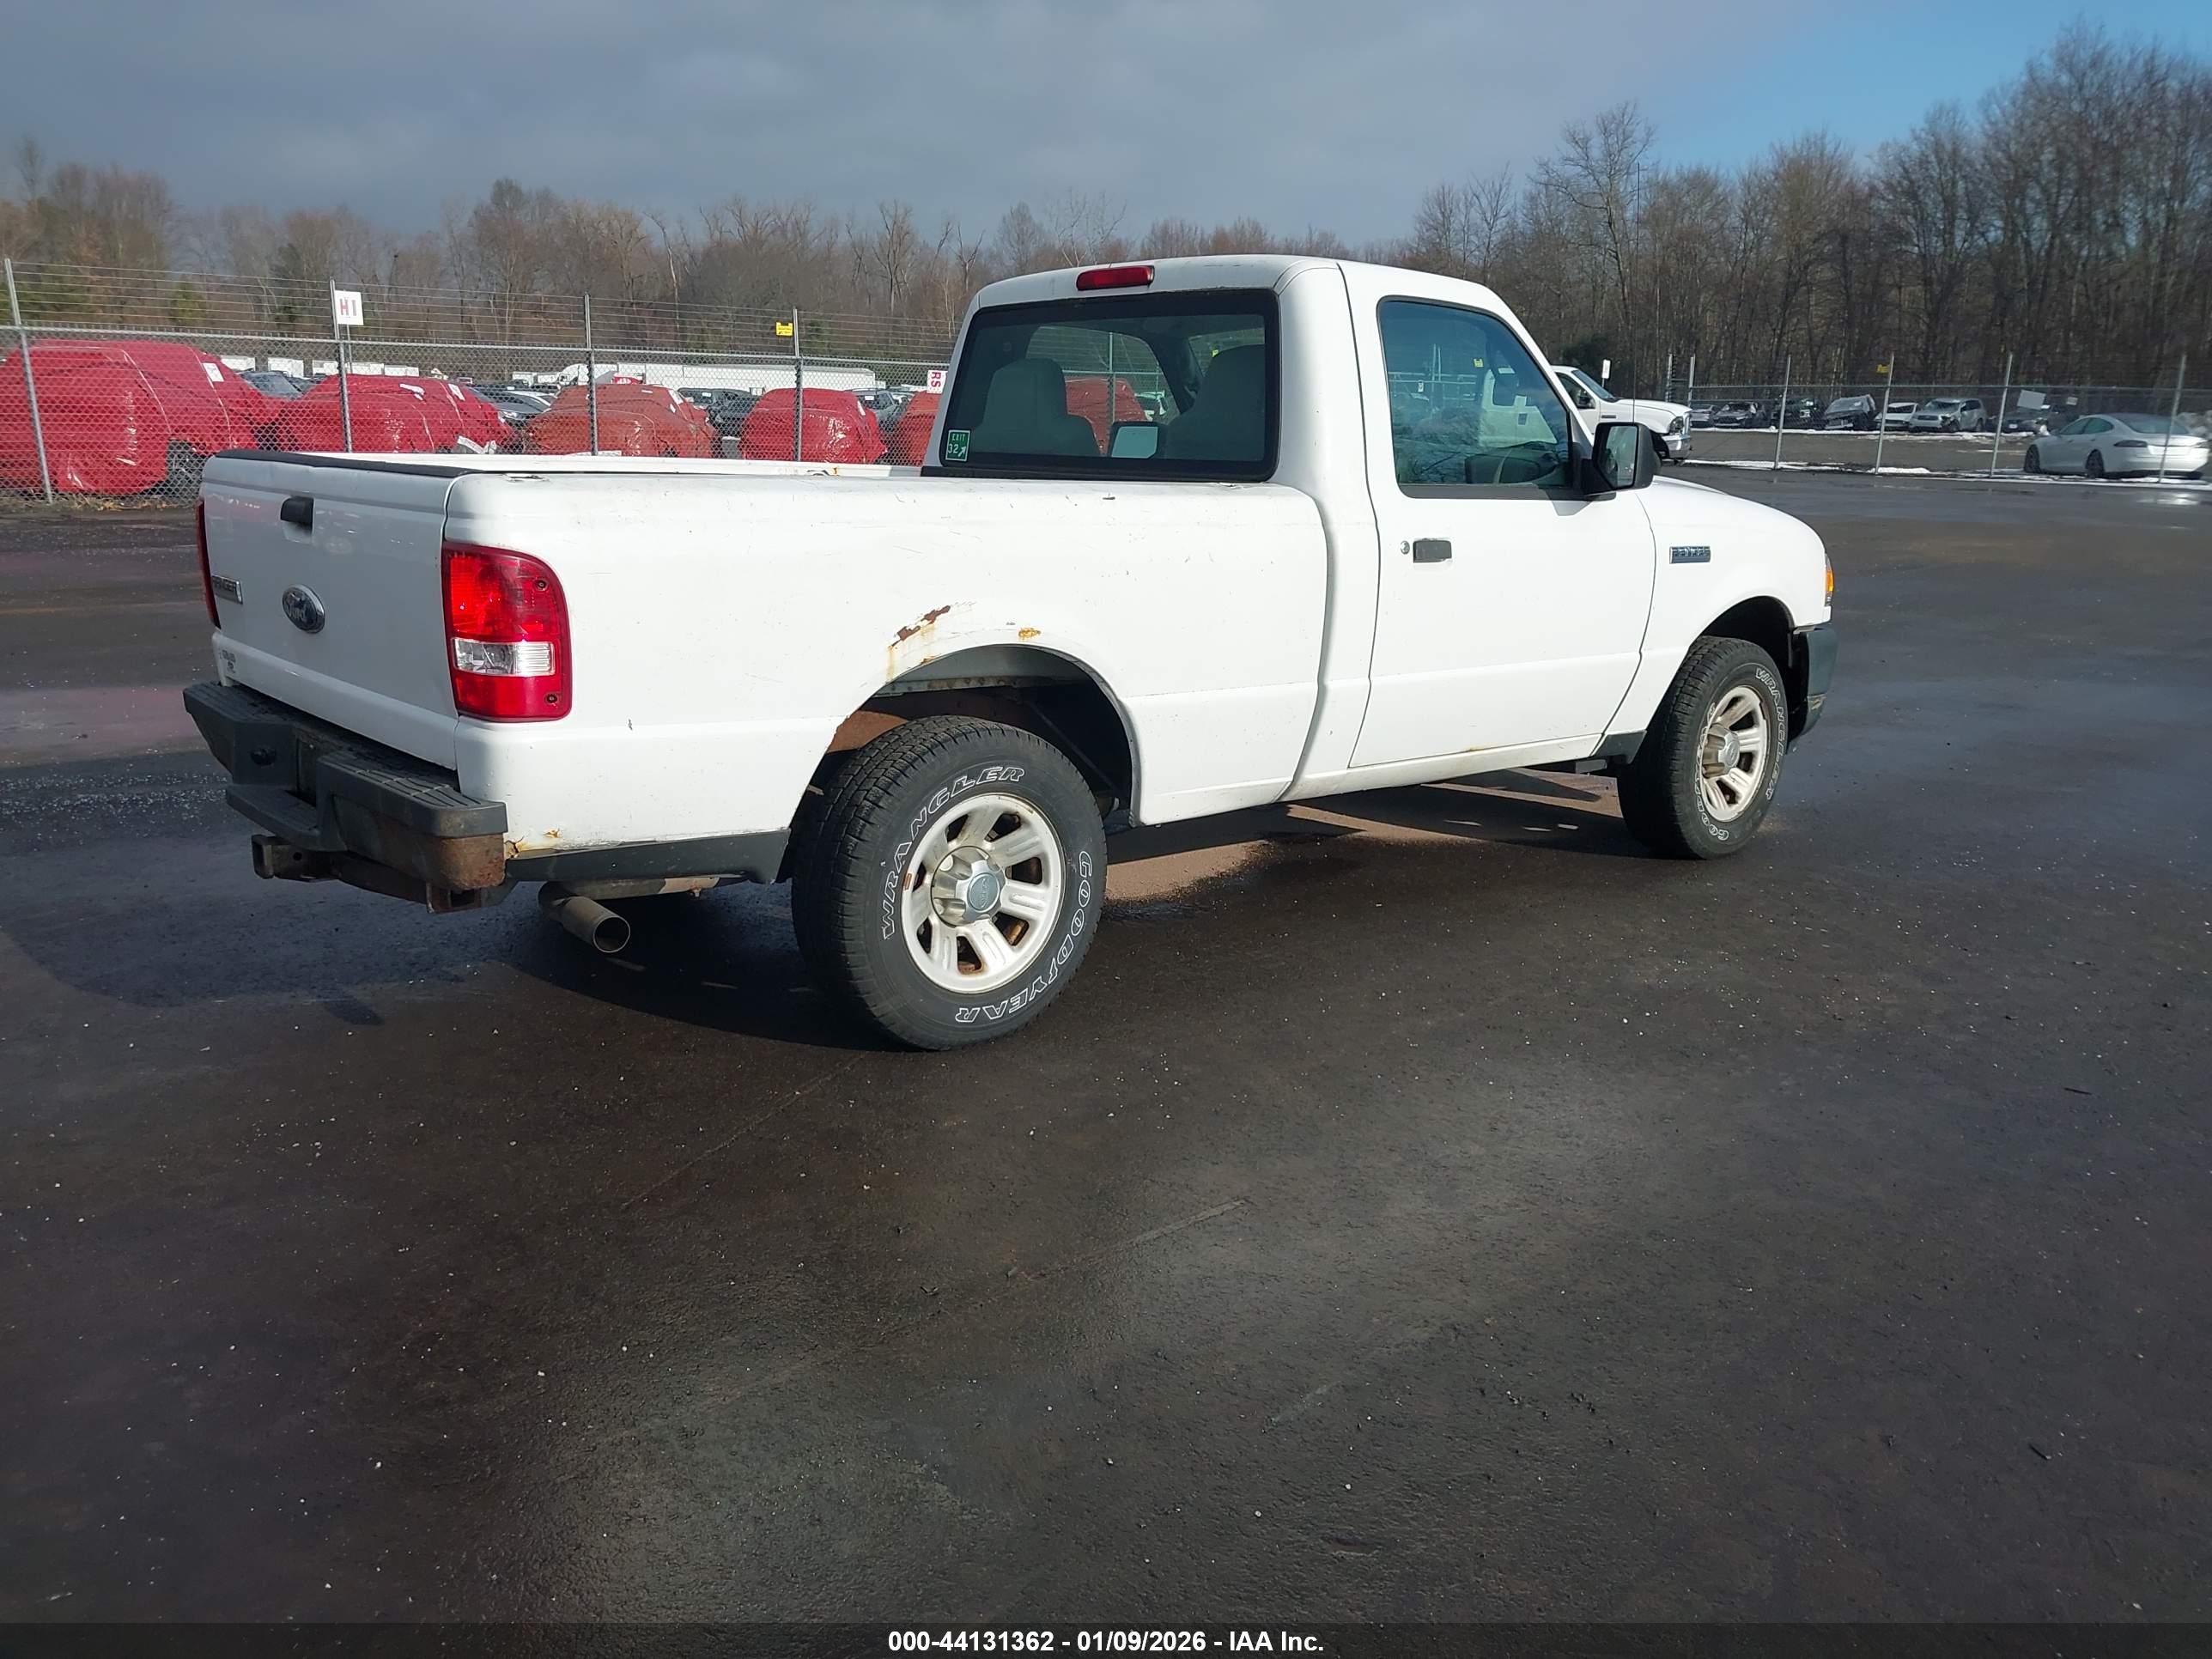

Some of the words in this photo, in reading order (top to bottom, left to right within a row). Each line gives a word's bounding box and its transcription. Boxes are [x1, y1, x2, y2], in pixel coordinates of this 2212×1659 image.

[931, 372, 942, 387] RS
[951, 433, 966, 441] EXIT
[1756, 667, 1785, 800] WRANGLER
[881, 766, 1025, 940] WRANGLER
[955, 850, 1092, 1023] GOODYEAR
